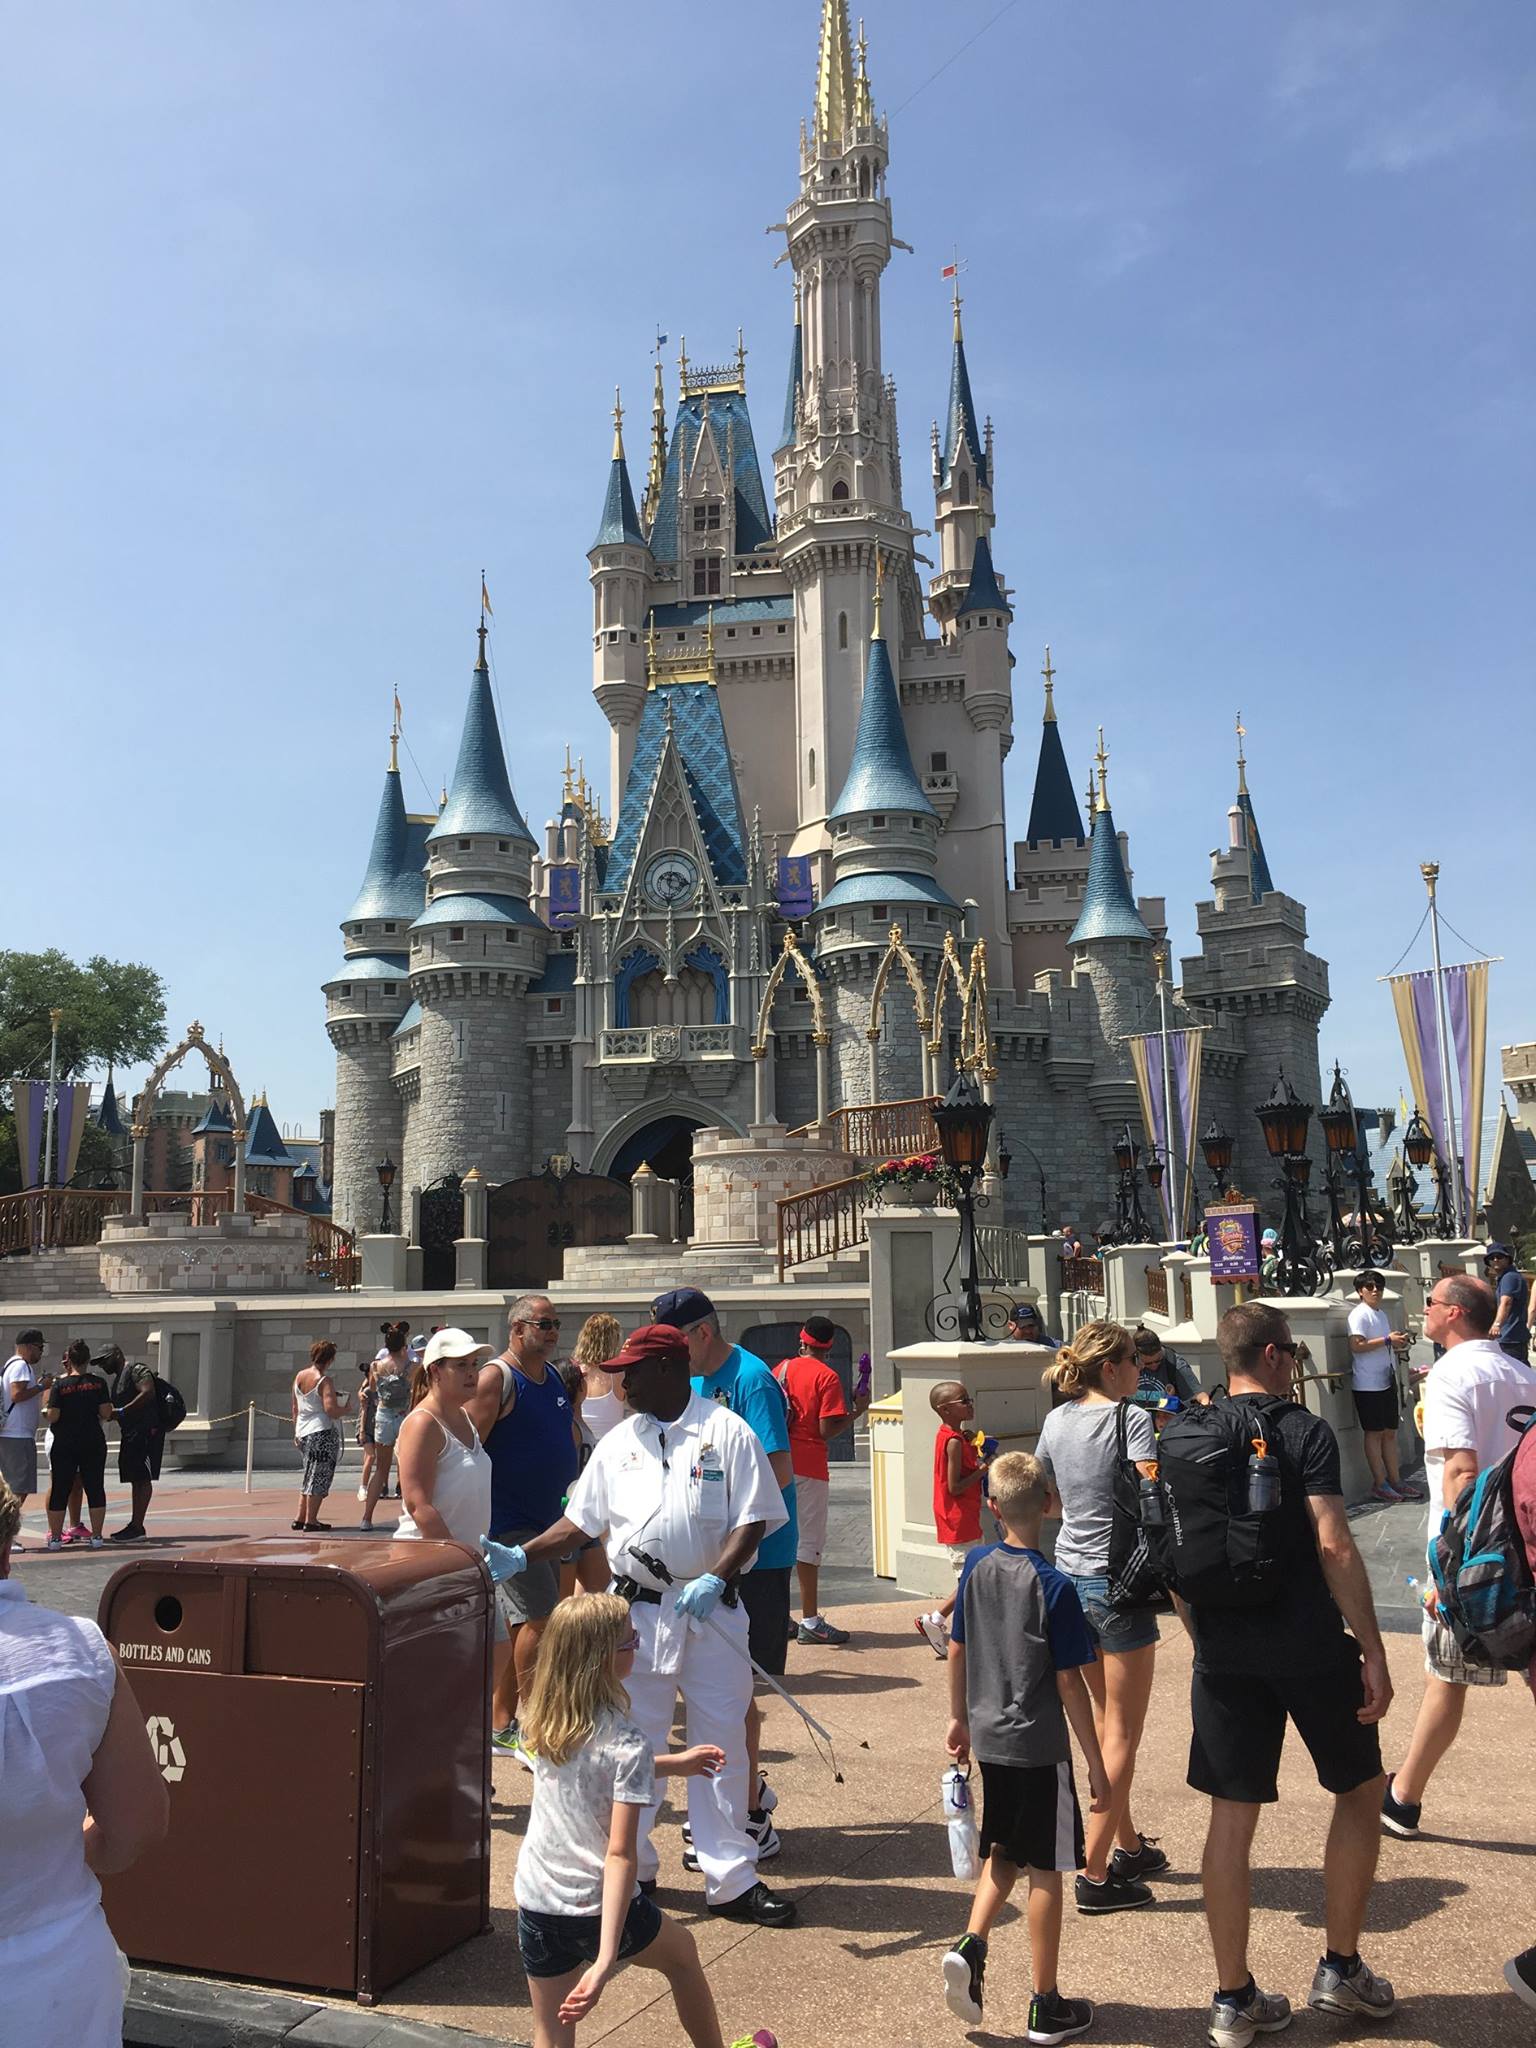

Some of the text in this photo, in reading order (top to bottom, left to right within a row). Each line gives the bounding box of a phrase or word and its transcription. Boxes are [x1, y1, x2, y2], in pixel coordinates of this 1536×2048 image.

[1167, 1494, 1183, 1546] Columbia
[119, 1642, 212, 1665] BOTTLES AND CANS
